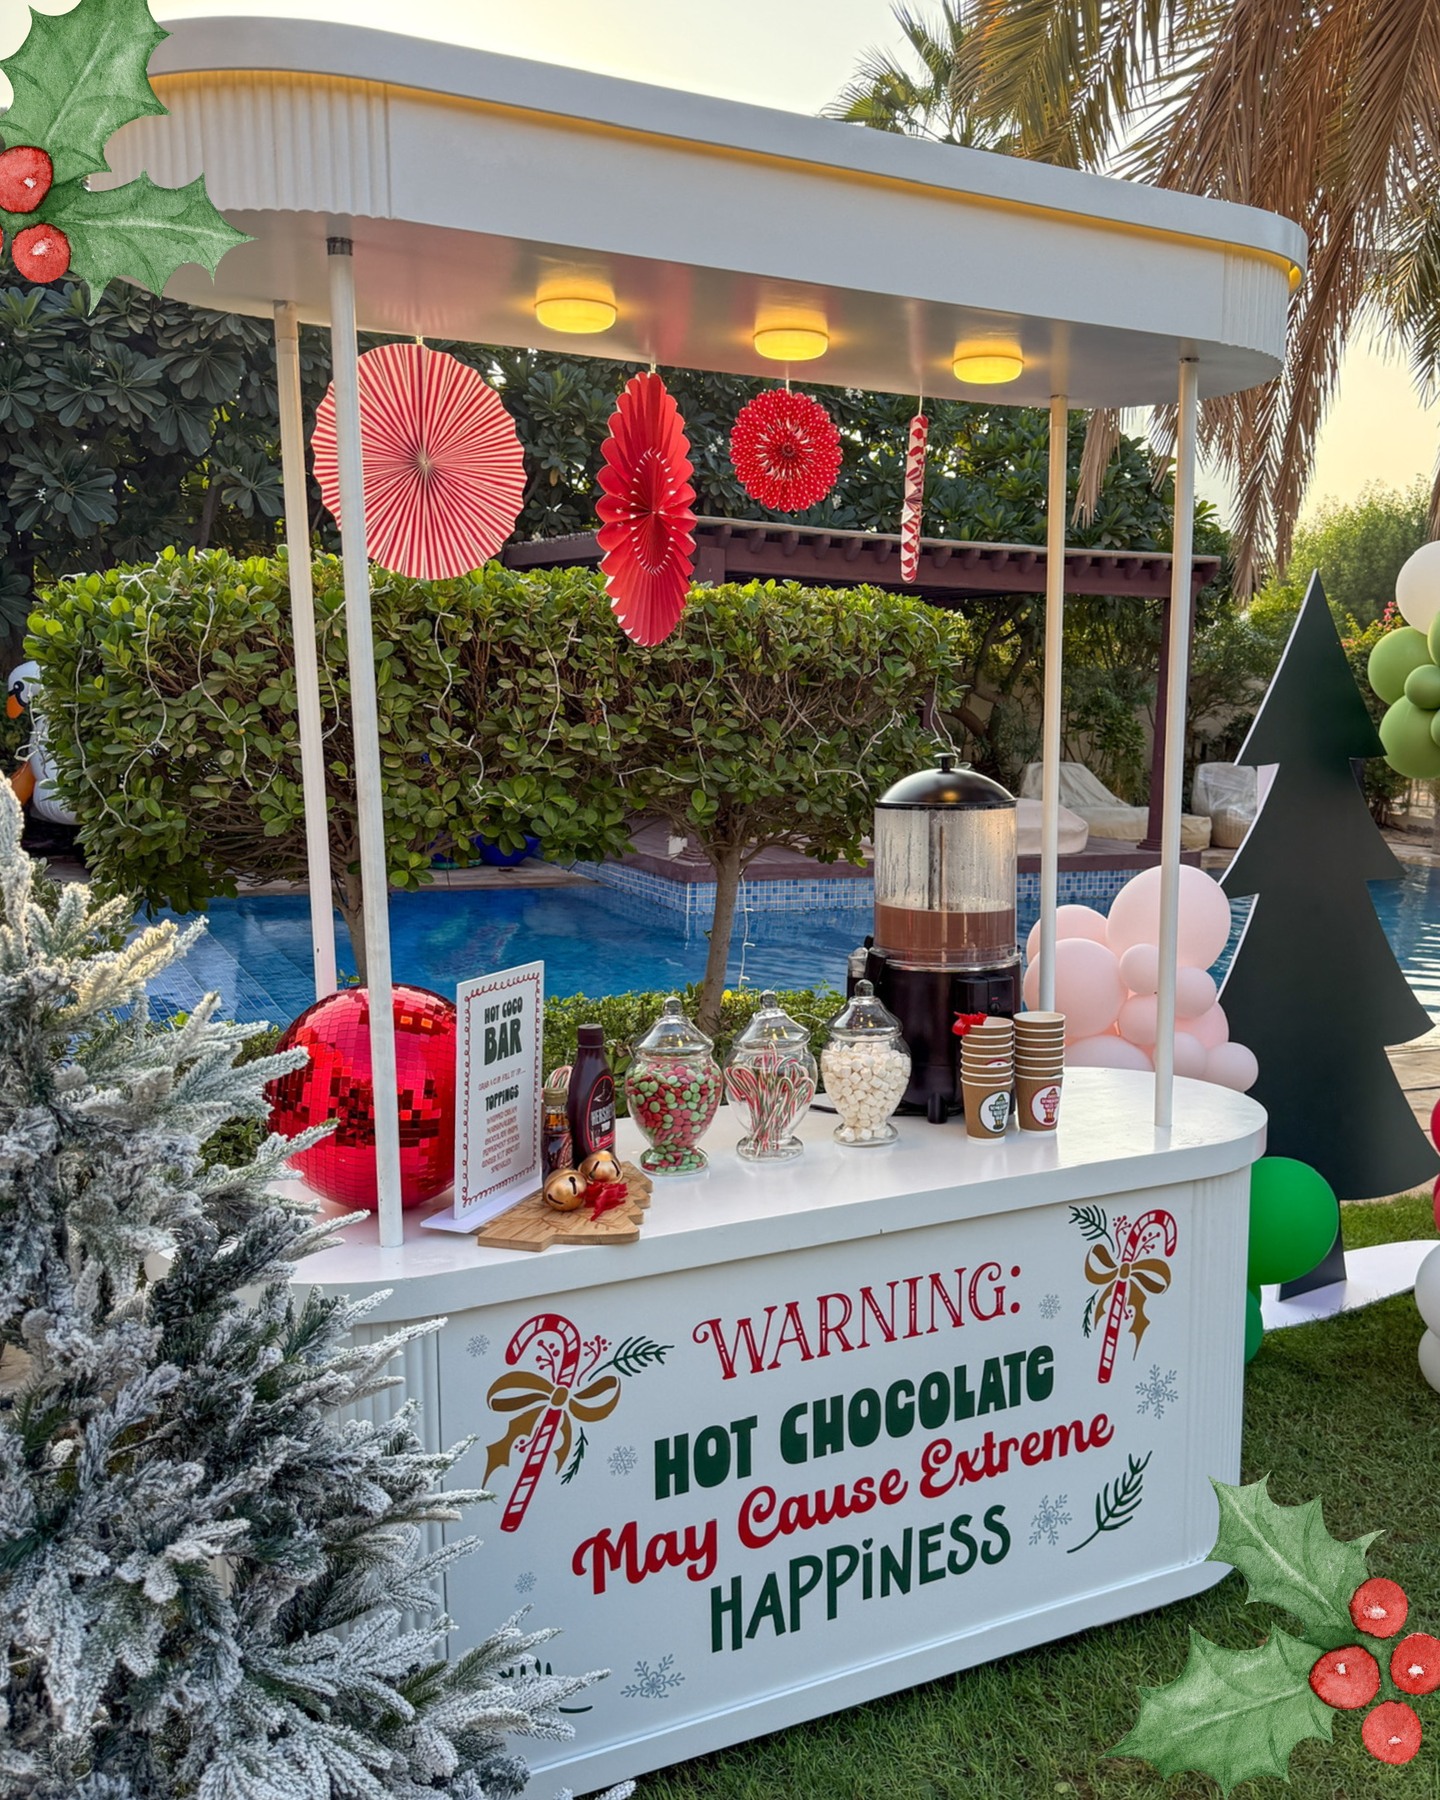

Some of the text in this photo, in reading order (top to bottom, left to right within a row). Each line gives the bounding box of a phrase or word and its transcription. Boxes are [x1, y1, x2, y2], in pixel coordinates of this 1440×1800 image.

[484, 996, 523, 1025] HOT COCO
[484, 1018, 523, 1066] BAR
[691, 1261, 1022, 1381] WARNING:
[654, 1345, 1055, 1501] HOT CHOCOLATE
[571, 1413, 1115, 1595] May Cause Extreme
